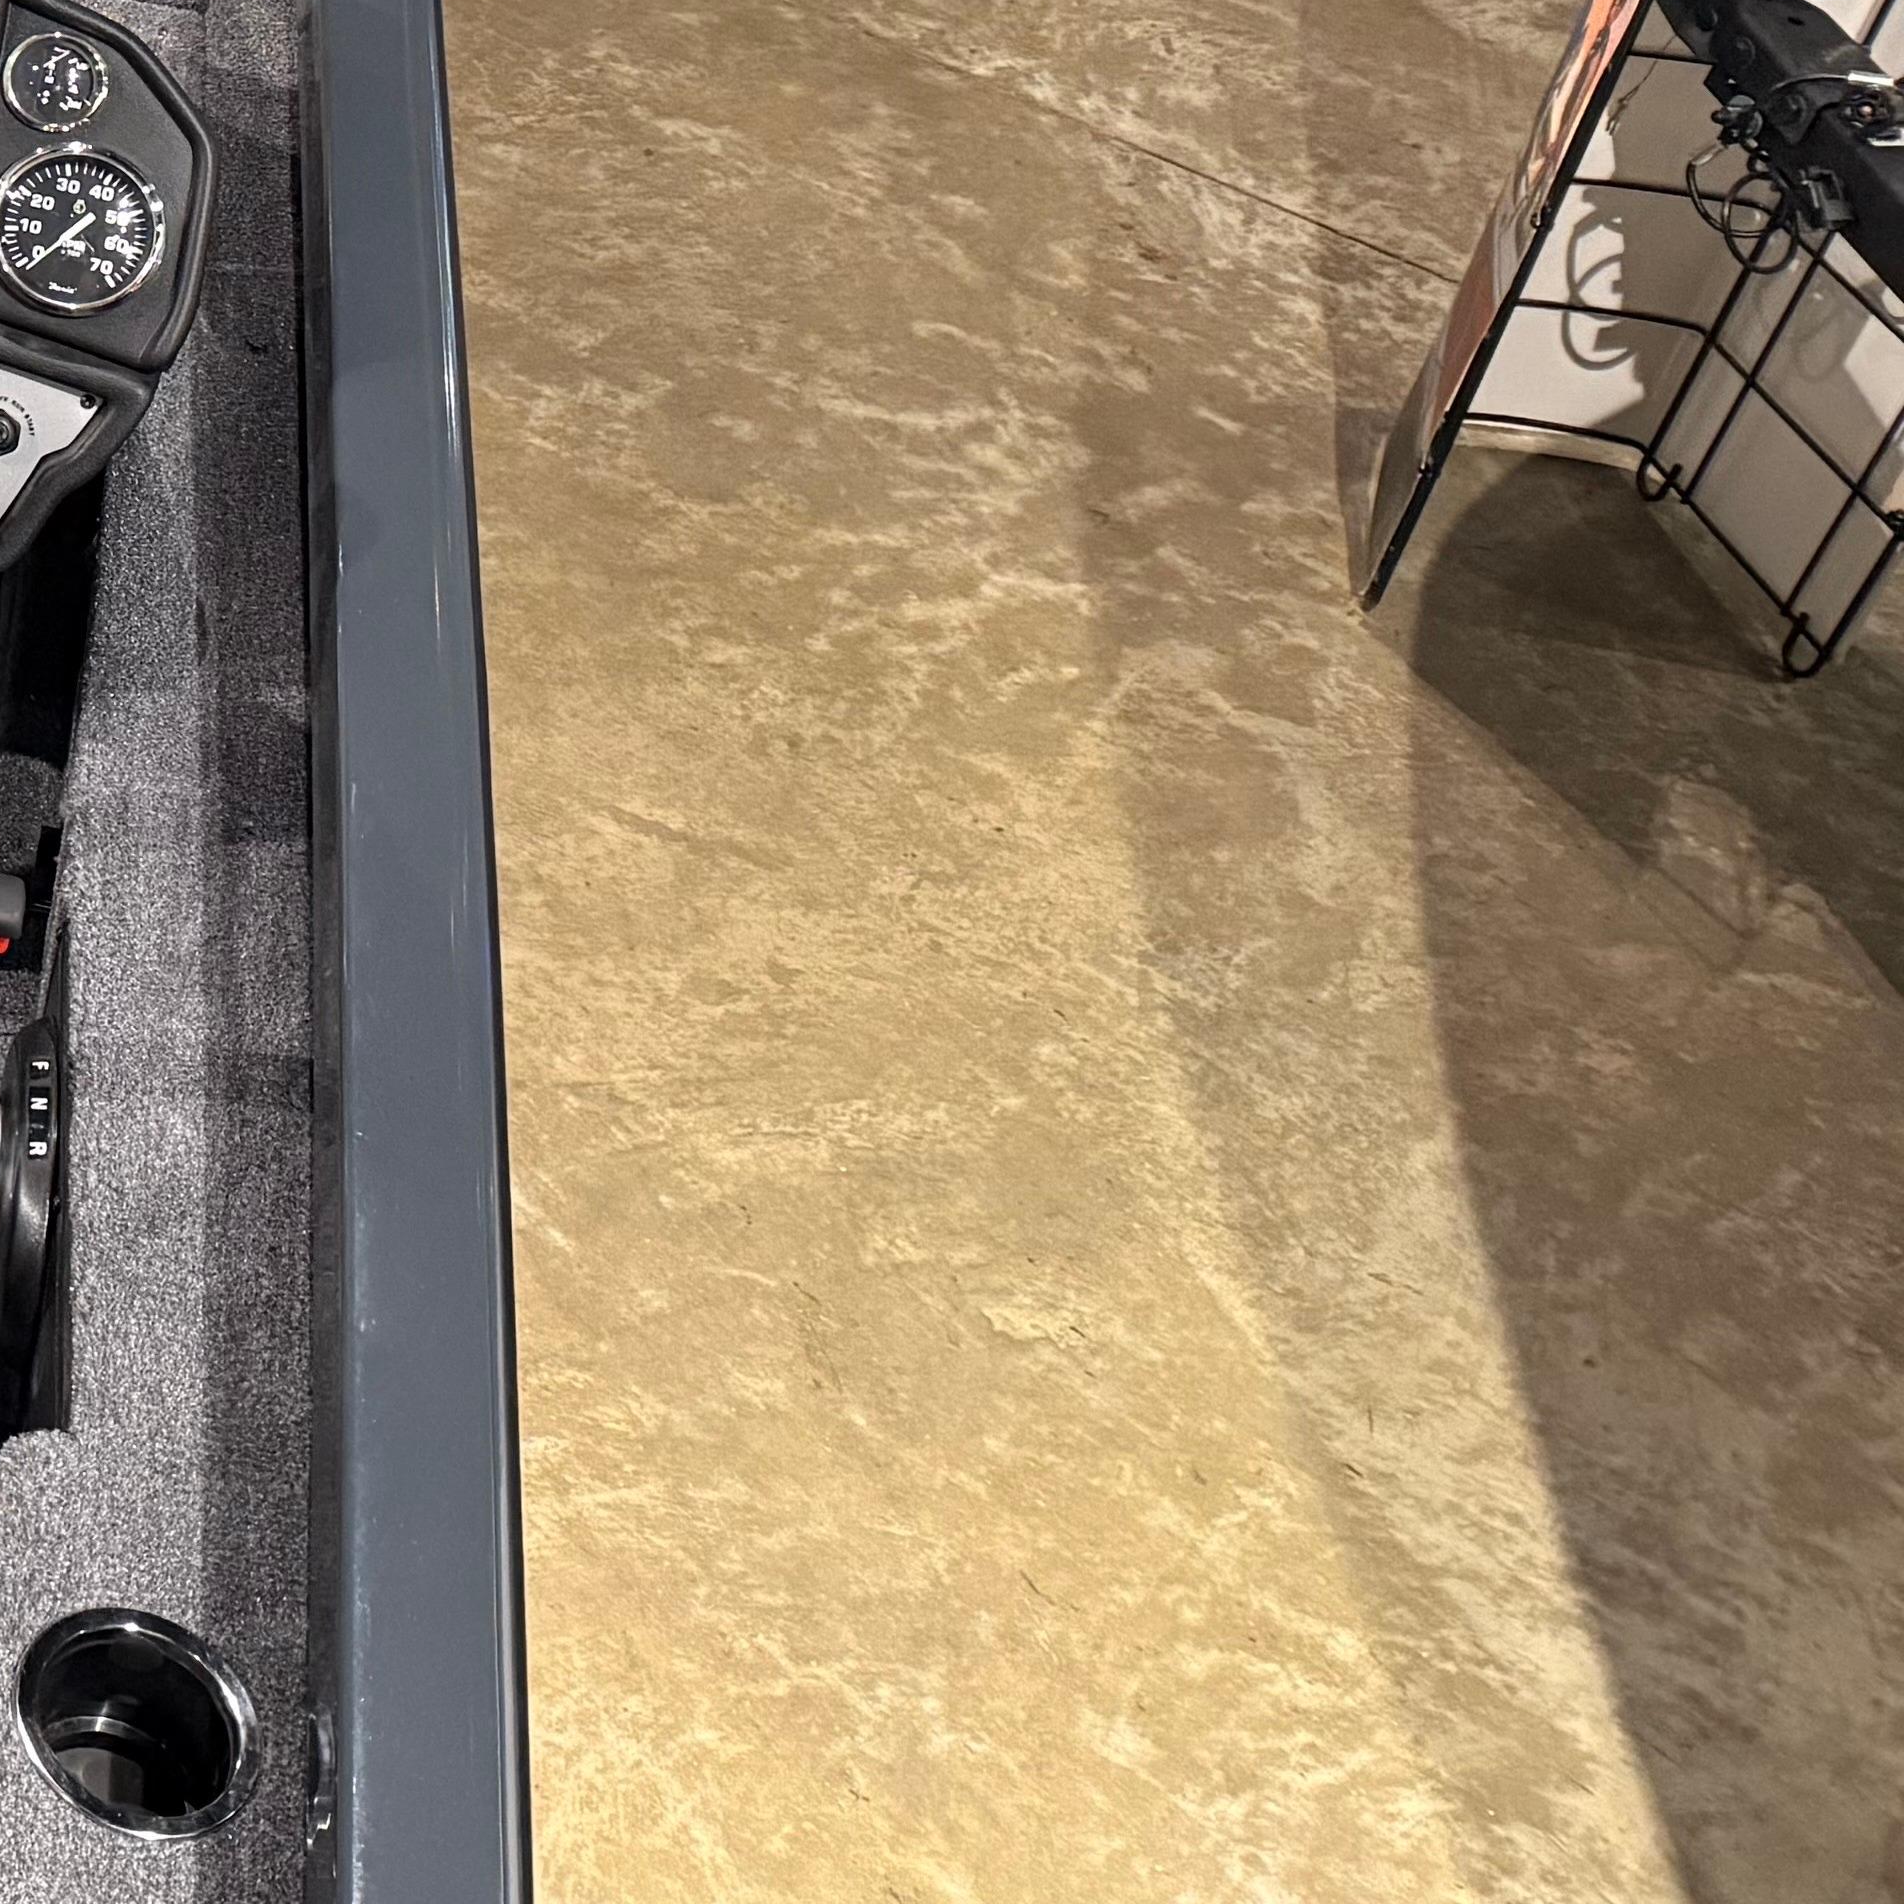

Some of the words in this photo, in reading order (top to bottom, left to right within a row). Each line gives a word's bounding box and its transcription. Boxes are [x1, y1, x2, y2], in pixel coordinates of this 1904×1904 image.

[56, 177, 80, 194] 30
[89, 185, 114, 201] 40
[30, 194, 55, 211] 20
[19, 218, 42, 234] 10
[104, 236, 129, 254] 60
[90, 257, 114, 275] 70
[32, 1061, 49, 1070] F
[30, 1097, 48, 1110] N
[29, 1141, 47, 1156] R
